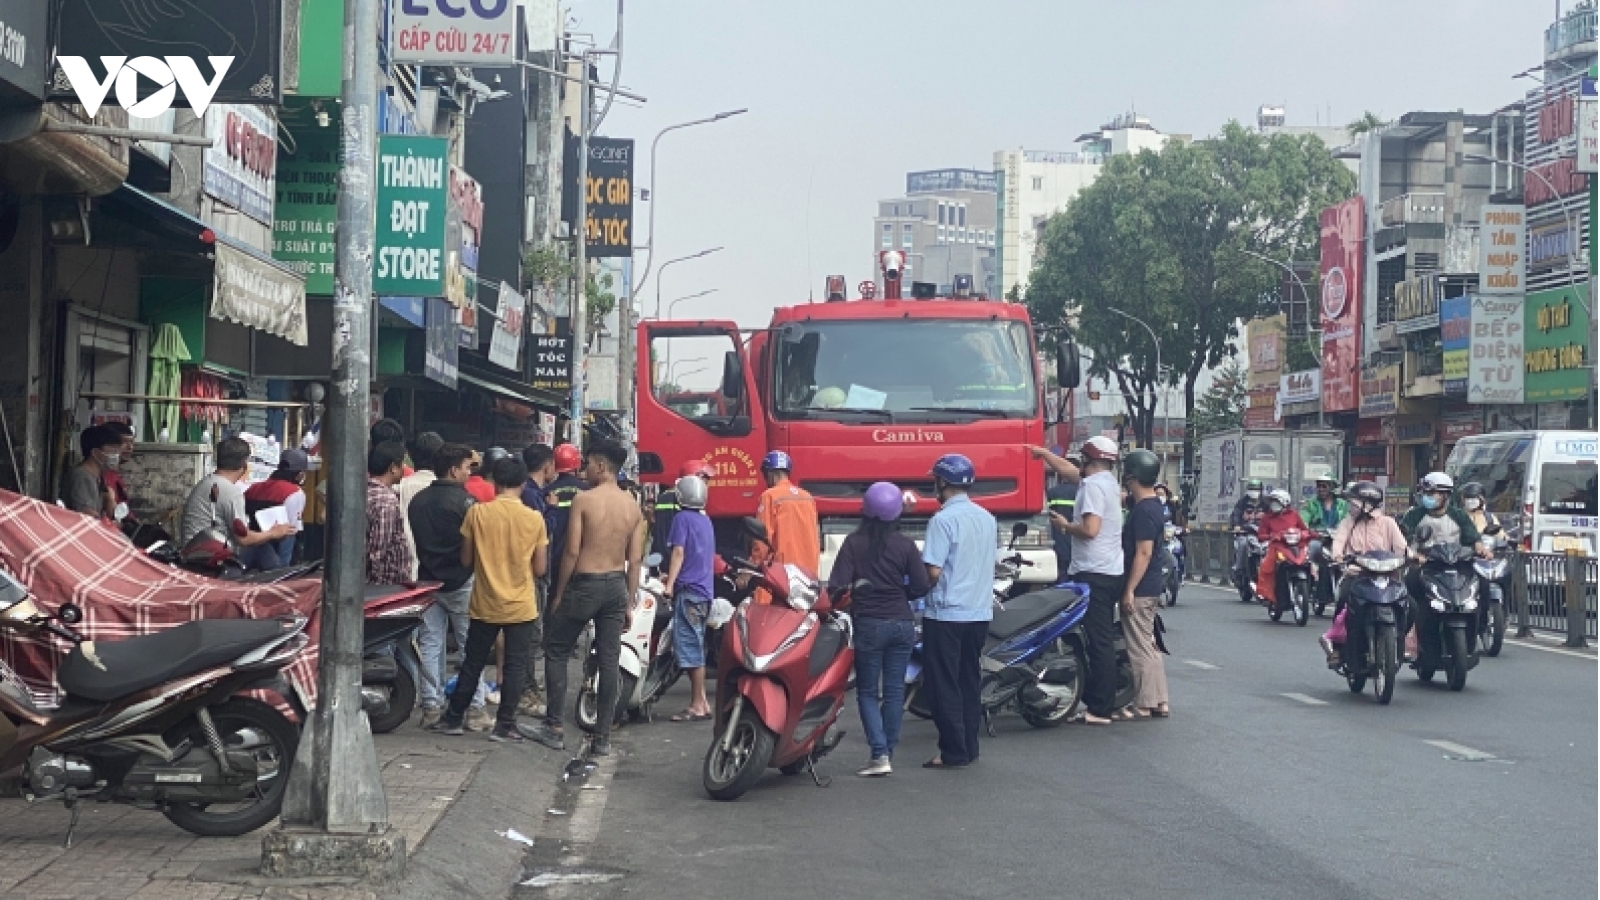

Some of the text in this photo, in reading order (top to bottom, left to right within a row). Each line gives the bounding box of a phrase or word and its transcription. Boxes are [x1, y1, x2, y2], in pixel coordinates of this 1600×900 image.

[399, 21, 511, 55] CẤP CỨU 24/7
[381, 147, 444, 190] THÀNH
[577, 170, 630, 205] ÓC GIẢ
[390, 200, 430, 239] ĐẠT
[602, 212, 629, 246] TÓC
[1485, 207, 1523, 226] PHÒNG
[377, 246, 441, 281] STORE
[1487, 250, 1519, 267] NHẬP
[1474, 316, 1523, 338] BẾP
[534, 366, 568, 377] NAM
[872, 427, 945, 443] Camiva
[714, 461, 738, 476] 114
